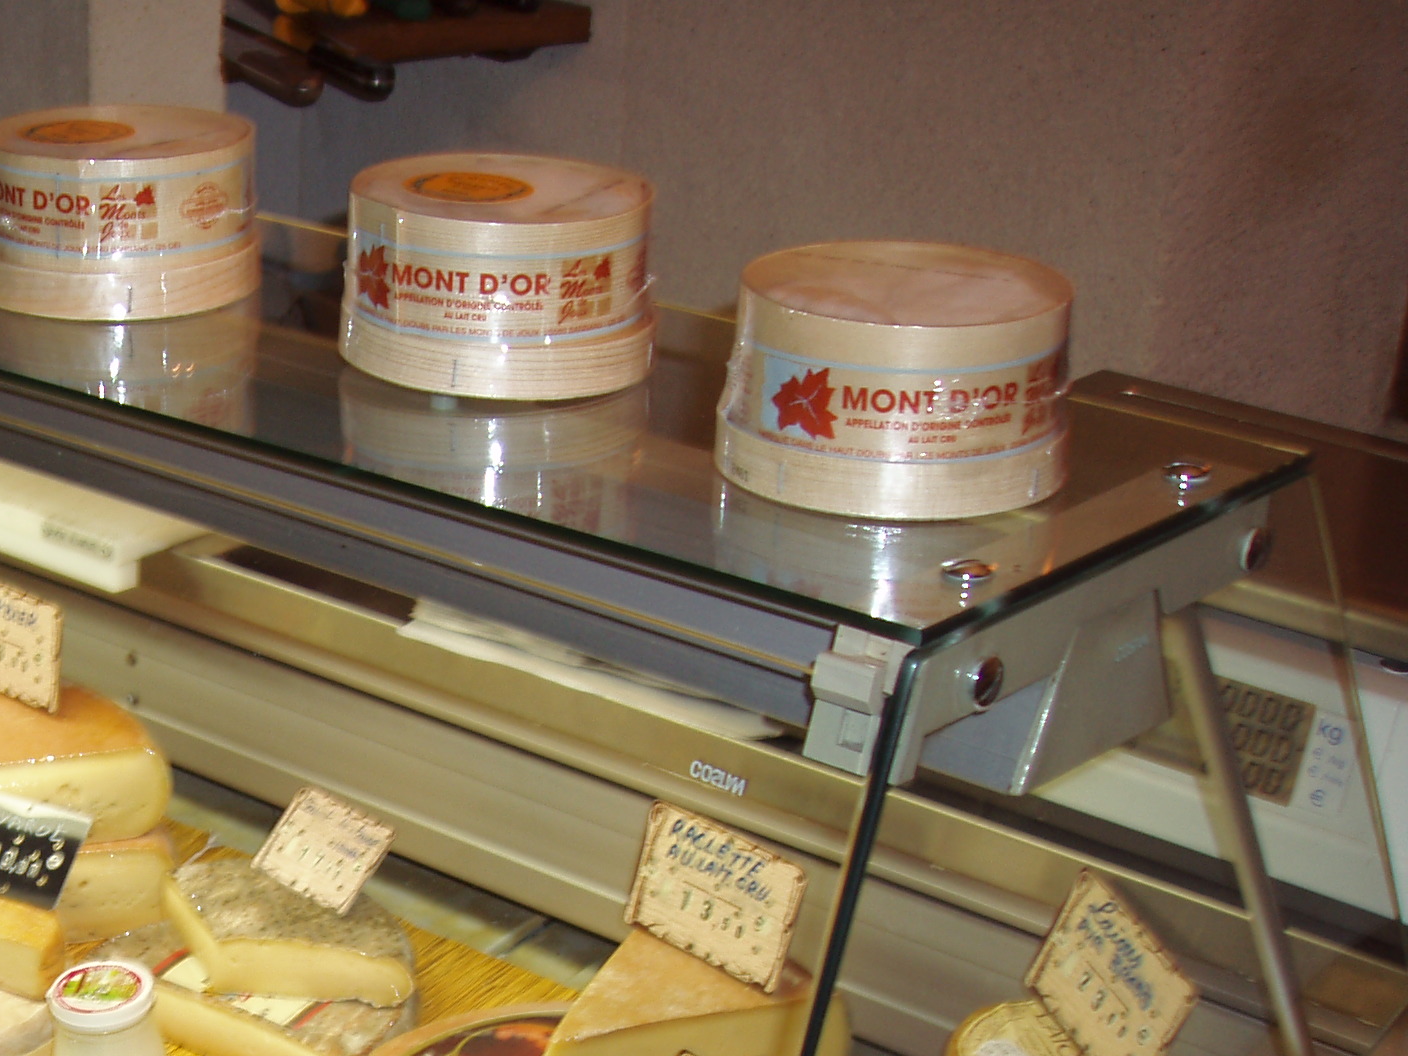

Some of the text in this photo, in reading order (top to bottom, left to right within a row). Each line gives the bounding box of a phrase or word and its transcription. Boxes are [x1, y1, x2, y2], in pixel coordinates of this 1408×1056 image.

[392, 263, 551, 297] MONT D'OR
[842, 385, 936, 415] MONT
[1317, 718, 1344, 746] kg
